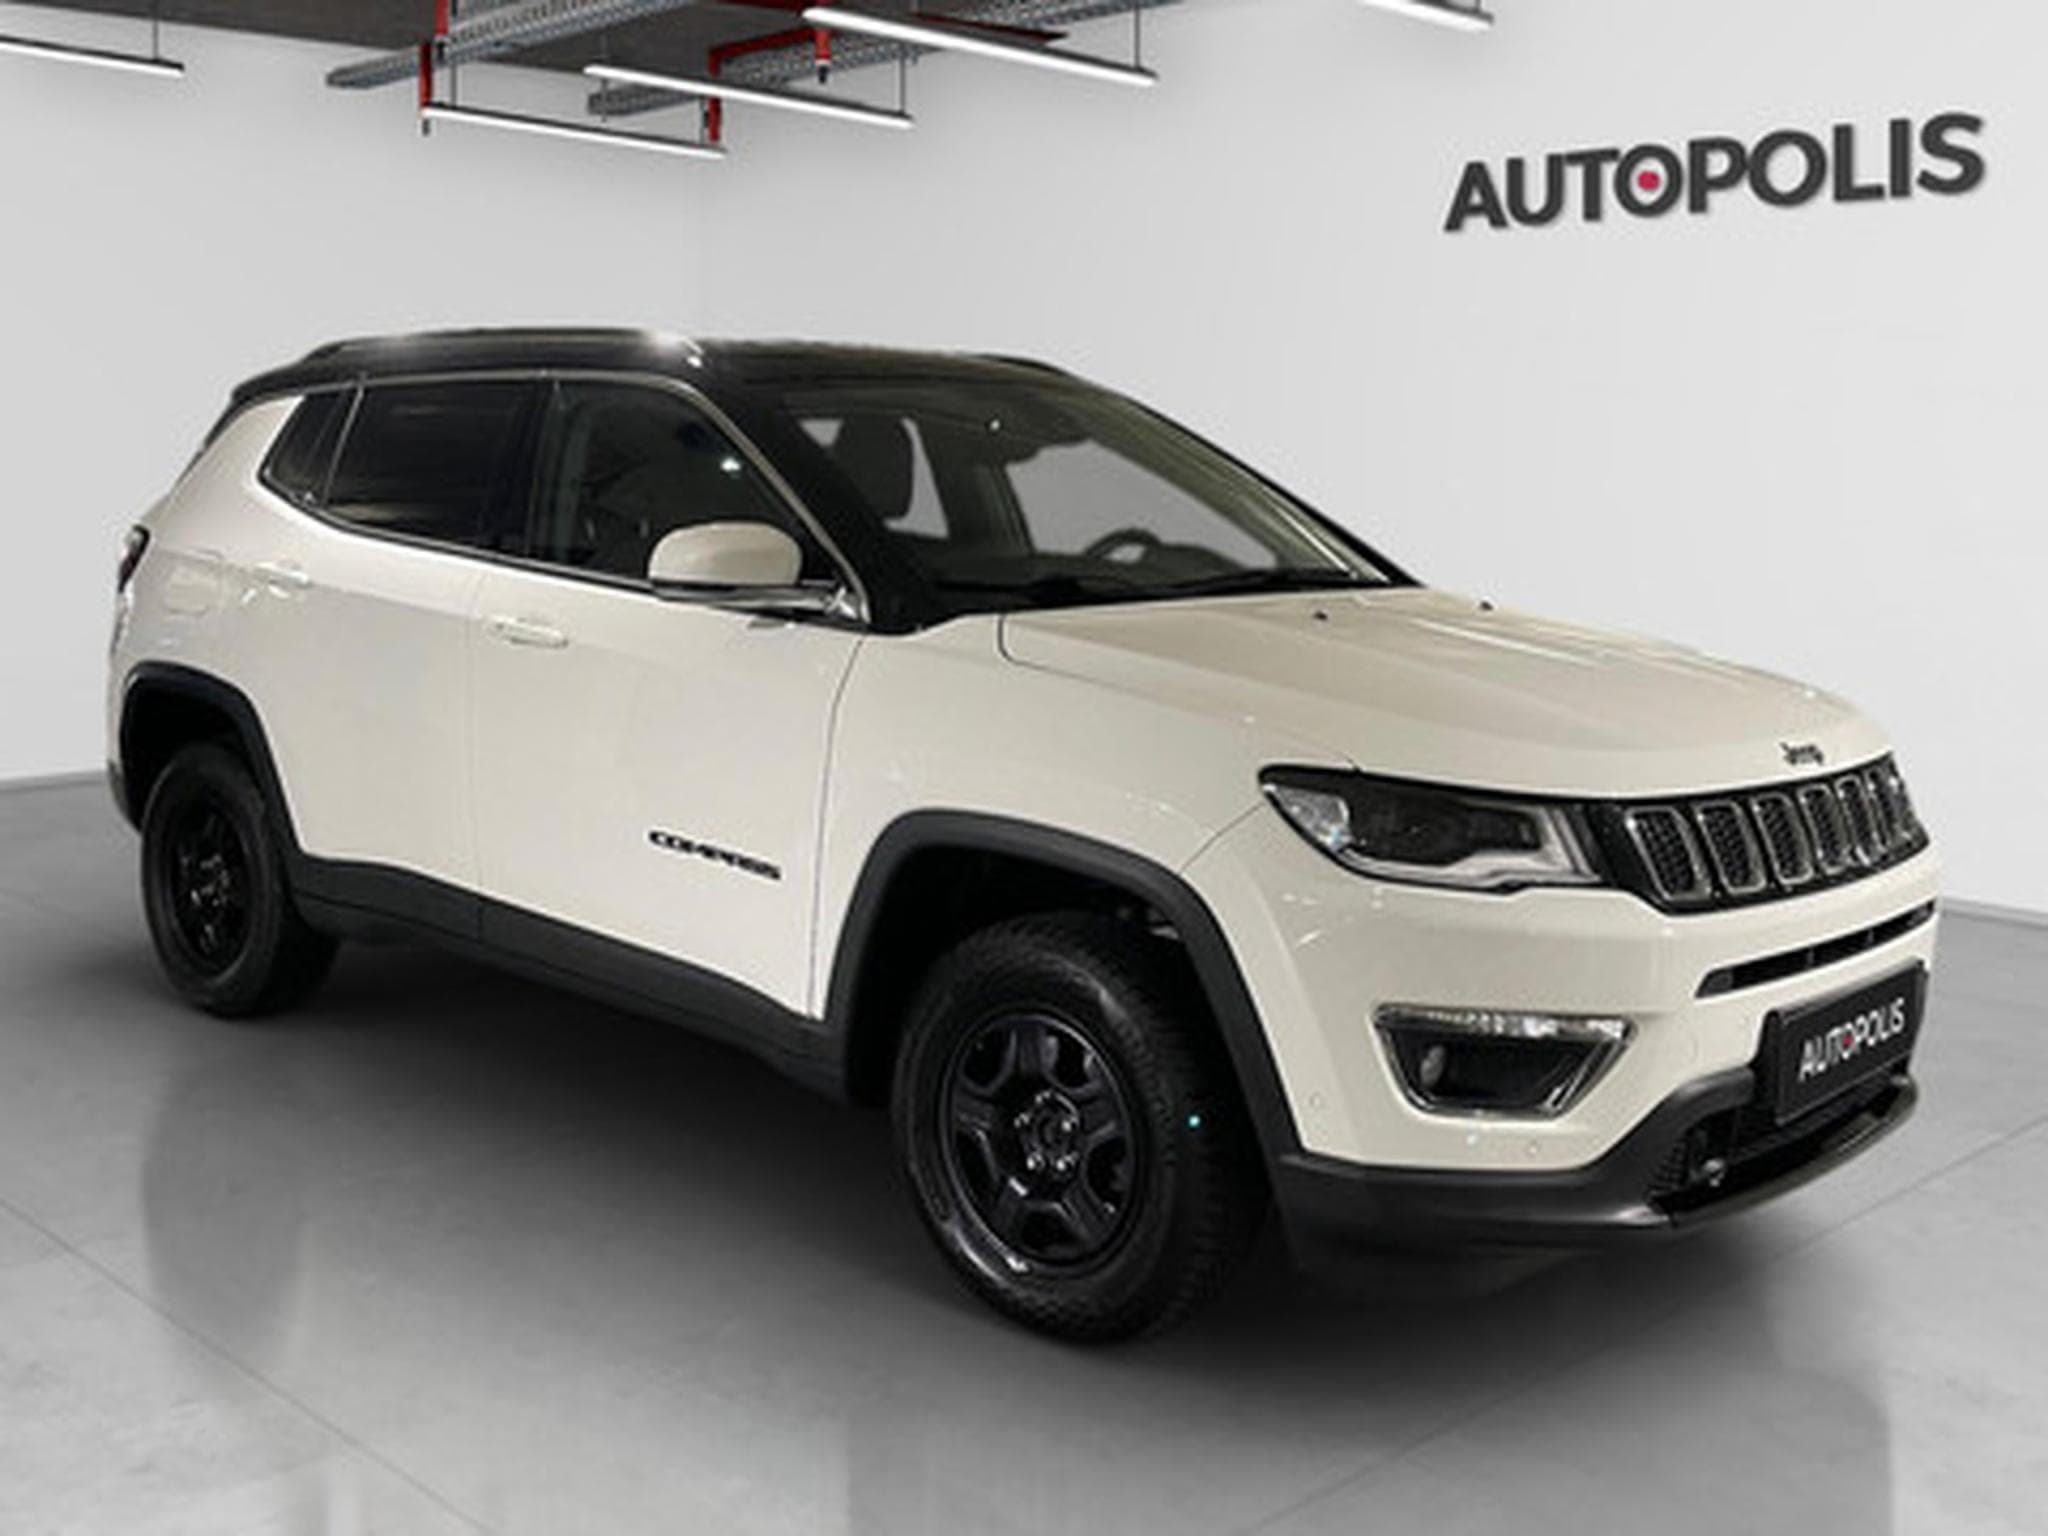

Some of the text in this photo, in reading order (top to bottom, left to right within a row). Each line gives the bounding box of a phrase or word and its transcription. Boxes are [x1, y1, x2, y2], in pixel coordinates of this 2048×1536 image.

[1443, 112, 1986, 233] AUTOPOLIS
[1780, 742, 1824, 767] Jeep
[649, 830, 781, 881] COMPASS
[1799, 998, 1905, 1081] AUTOPOLIS
